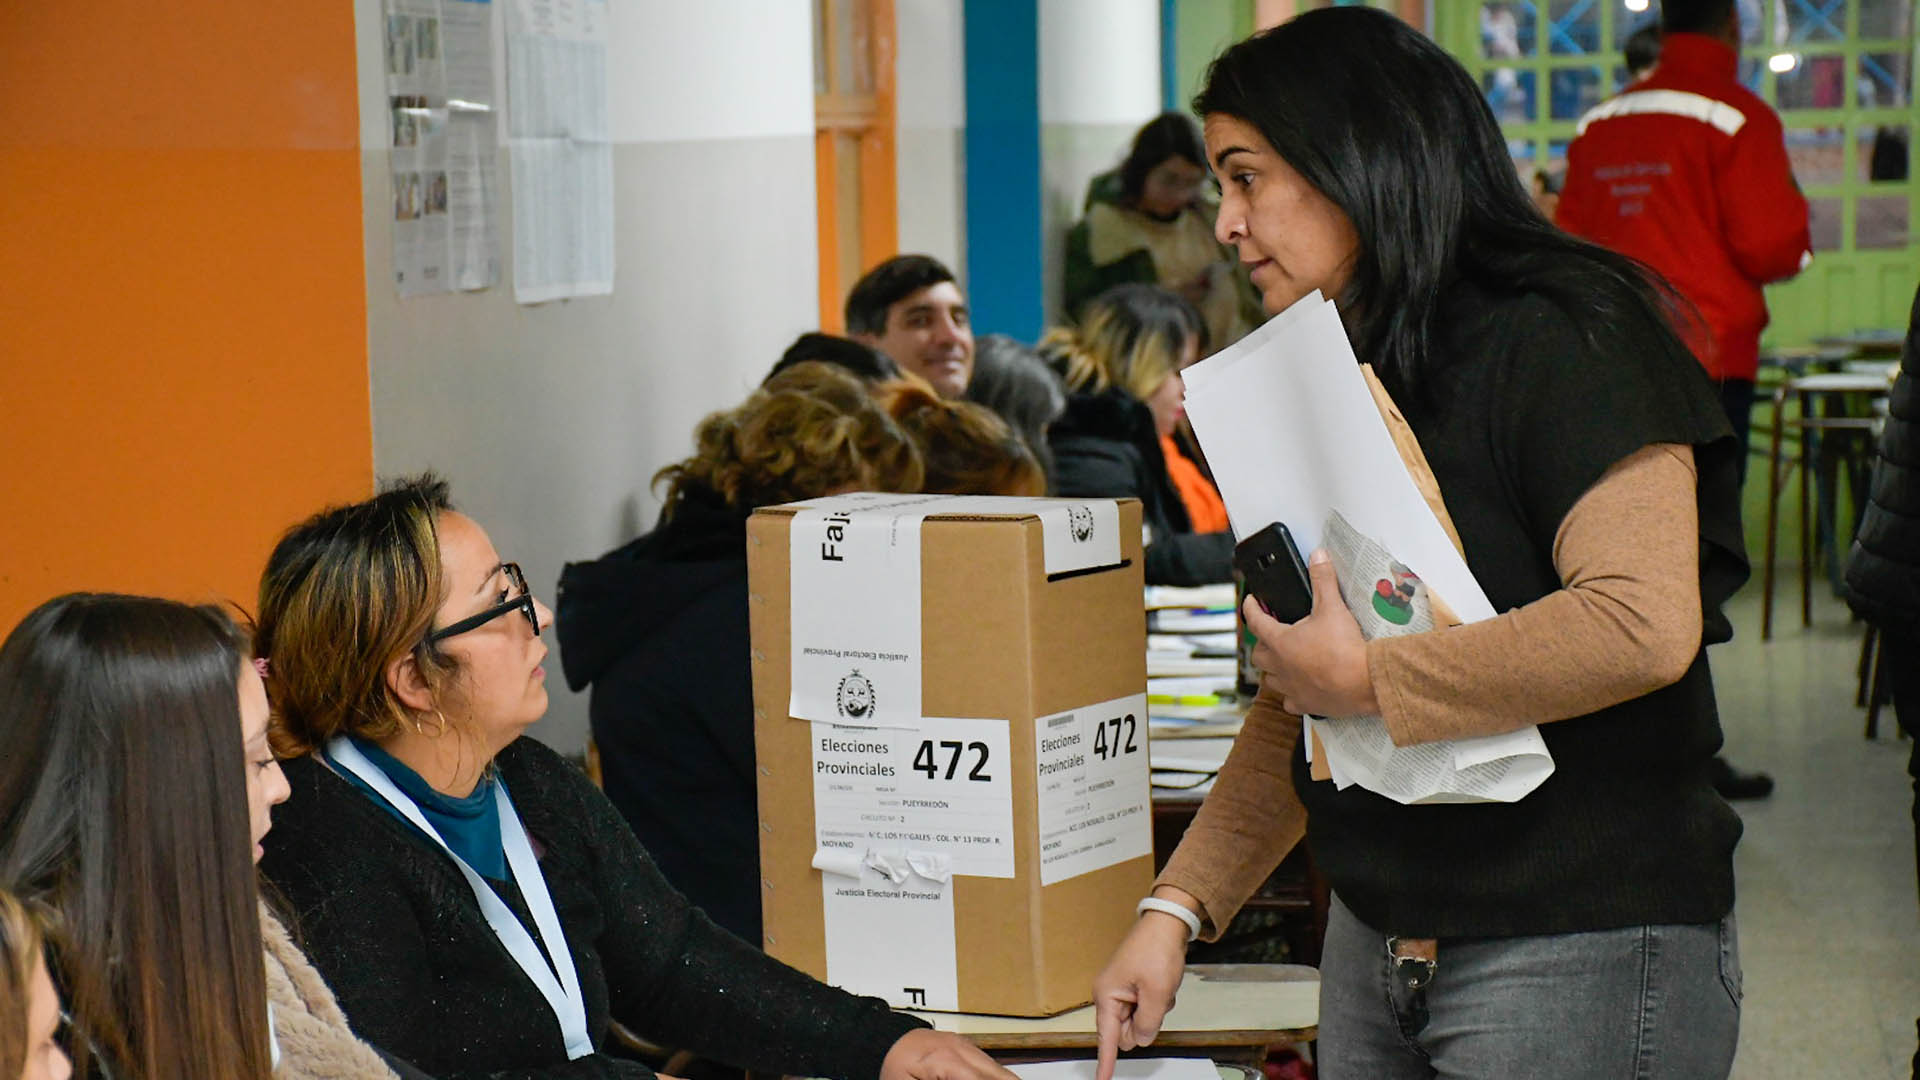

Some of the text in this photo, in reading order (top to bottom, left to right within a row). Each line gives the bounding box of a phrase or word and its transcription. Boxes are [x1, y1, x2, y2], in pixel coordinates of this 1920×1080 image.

[803, 648, 909, 662] Justicia Electoral Provincial
[1041, 732, 1081, 753] Elecciones
[1094, 713, 1137, 761] 472
[821, 738, 888, 754] Elecciones
[817, 761, 895, 777] Provinciales
[912, 740, 992, 782] 472
[1039, 754, 1085, 776] Provinciales
[821, 840, 854, 848] MOYANO
[835, 887, 941, 900] Justicia Electoral Provincial
